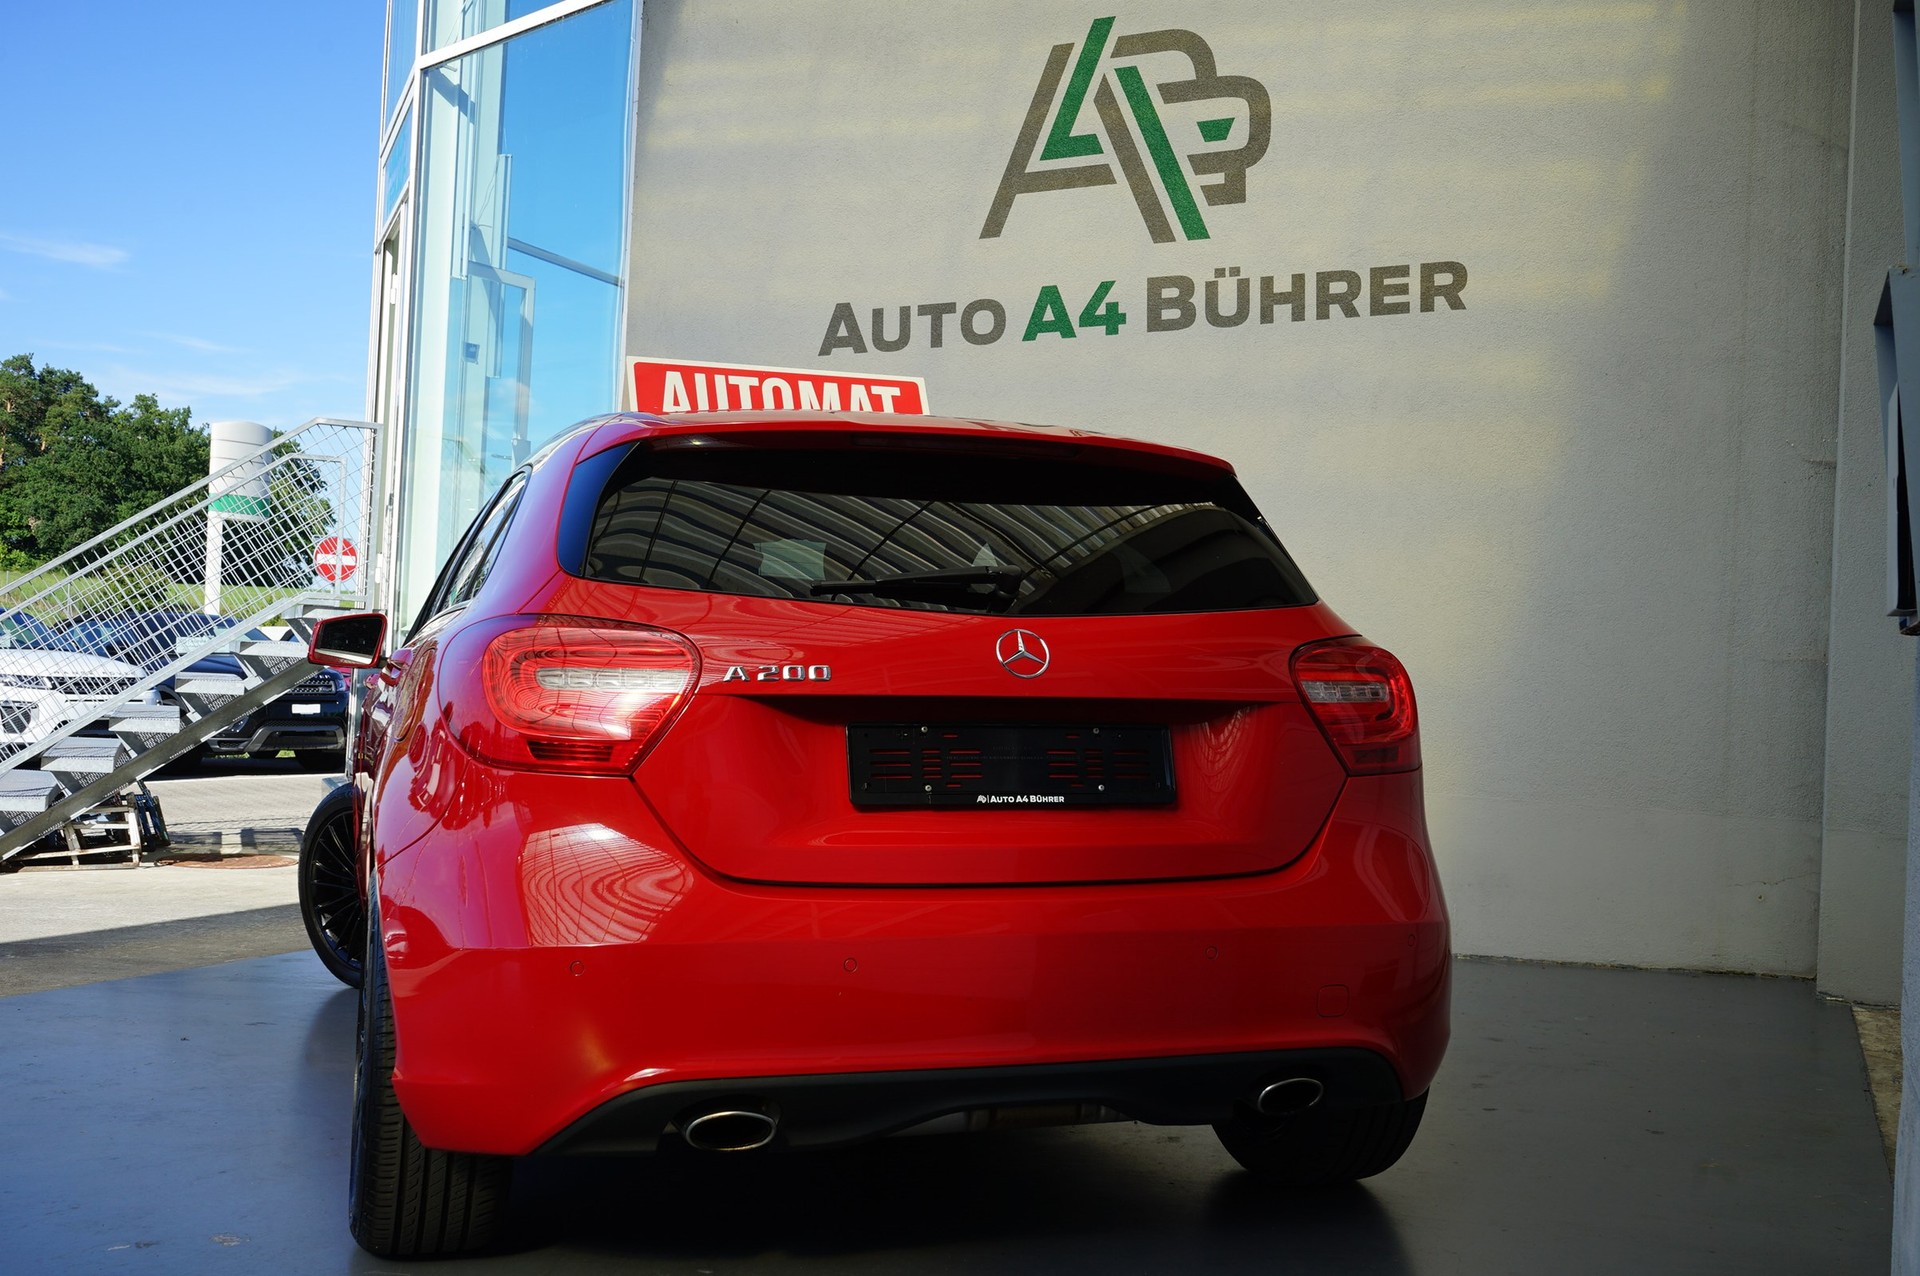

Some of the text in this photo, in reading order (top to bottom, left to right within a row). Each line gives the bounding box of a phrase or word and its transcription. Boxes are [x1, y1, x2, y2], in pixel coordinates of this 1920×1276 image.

[818, 260, 1468, 357] AUTO A4 BÜHRER
[662, 370, 902, 414] AUTOMAT
[722, 664, 832, 682] A 200
[990, 795, 1015, 803] AUTO
[1016, 794, 1029, 803] A4
[1030, 794, 1065, 803] BÜHRER
